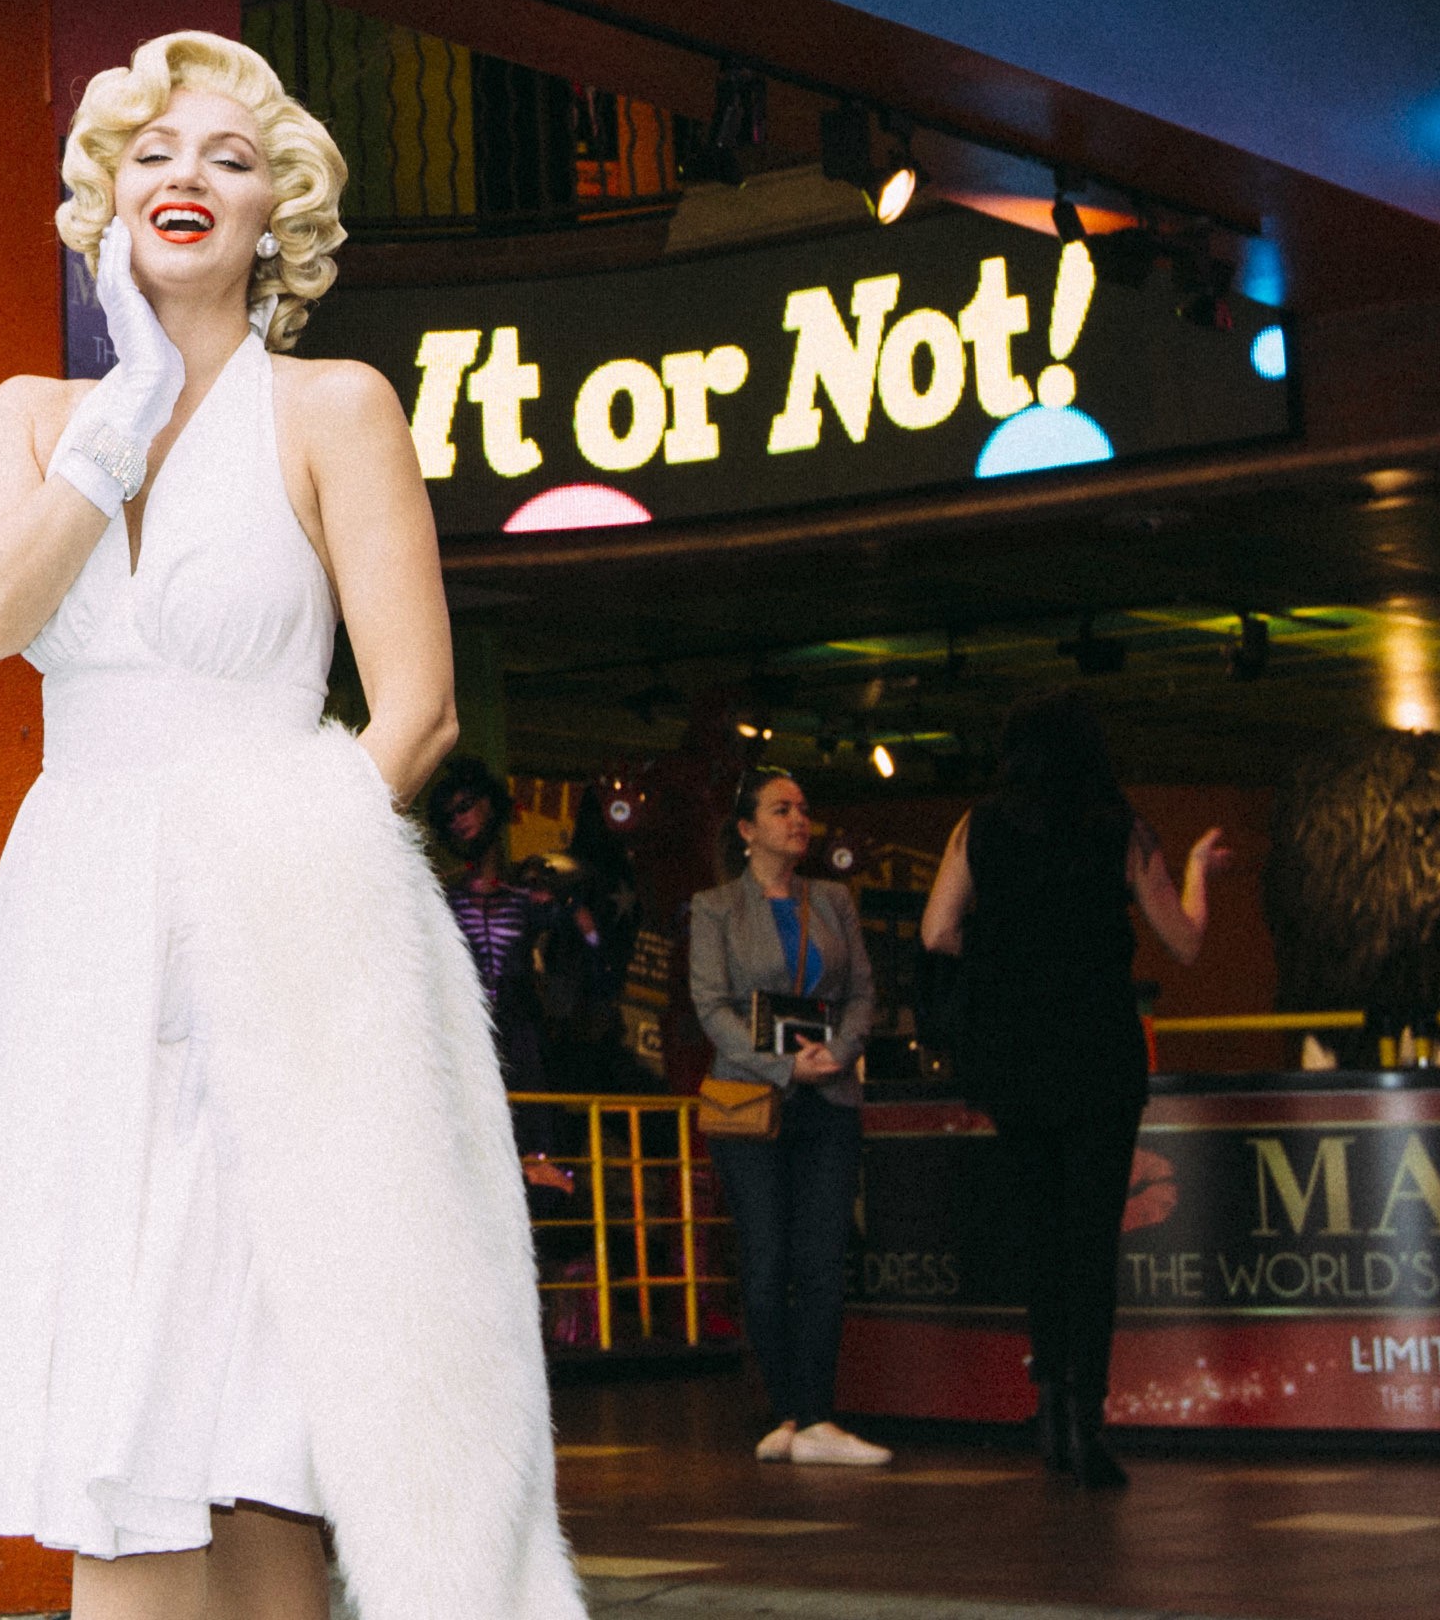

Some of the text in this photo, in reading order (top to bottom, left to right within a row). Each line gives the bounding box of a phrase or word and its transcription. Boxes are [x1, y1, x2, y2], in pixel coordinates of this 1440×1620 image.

[410, 238, 1097, 479] It or Not!
[862, 1250, 962, 1297] DRESS
[1124, 1250, 1203, 1299] THE
[1218, 1250, 1439, 1300] WORLD'S
